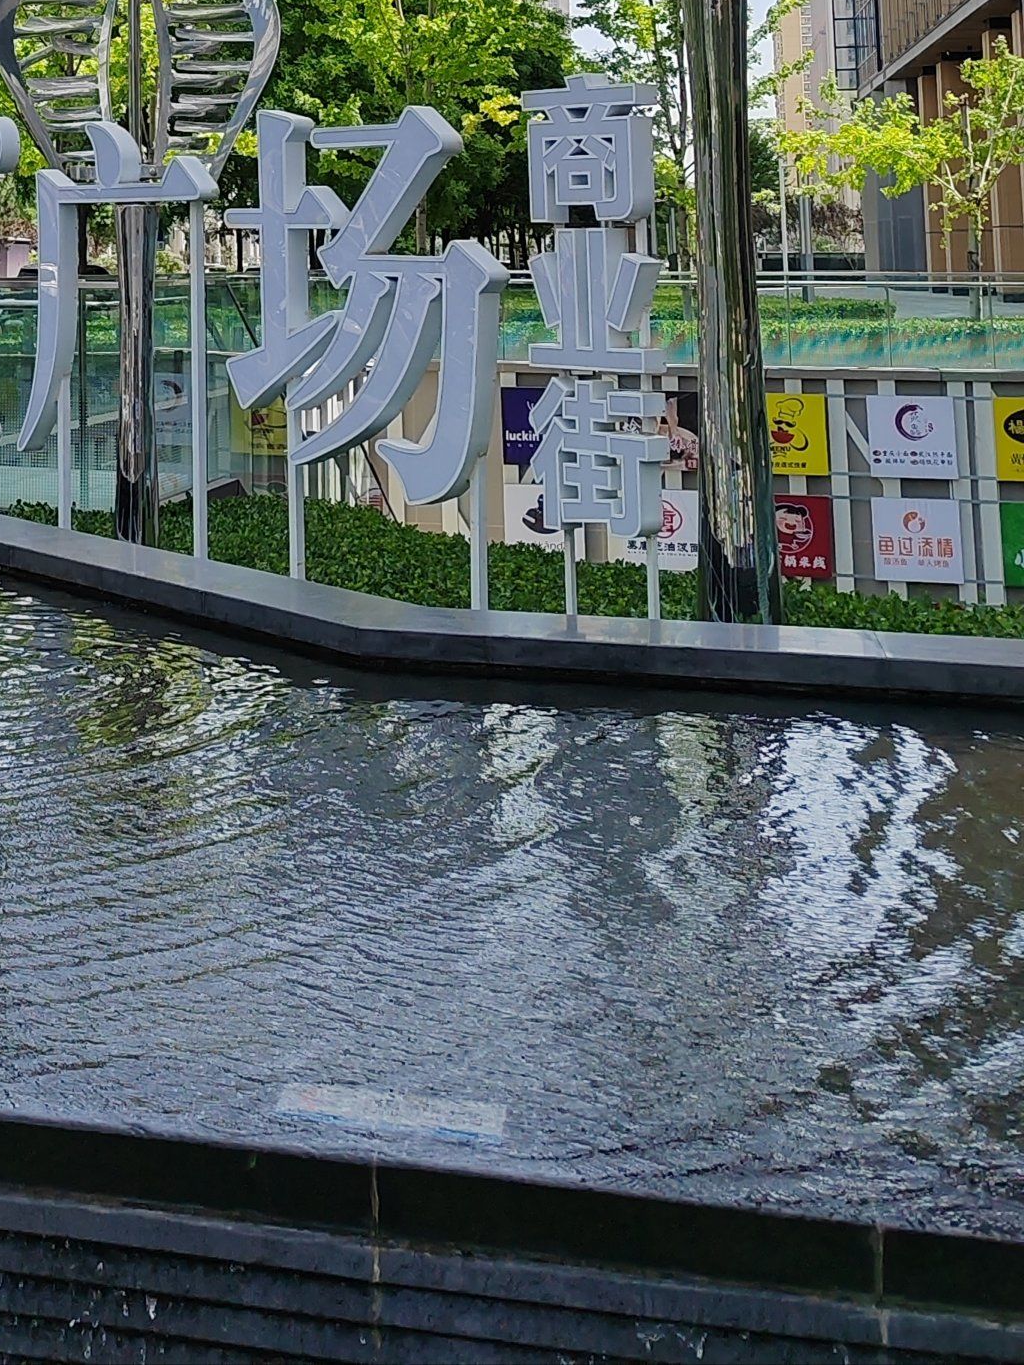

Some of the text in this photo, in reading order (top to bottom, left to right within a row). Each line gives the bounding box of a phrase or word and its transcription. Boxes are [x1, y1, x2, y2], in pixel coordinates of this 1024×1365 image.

[520, 74, 666, 538] 商业街
[506, 430, 540, 441] luckin
[878, 535, 954, 559] 鱼过添情
